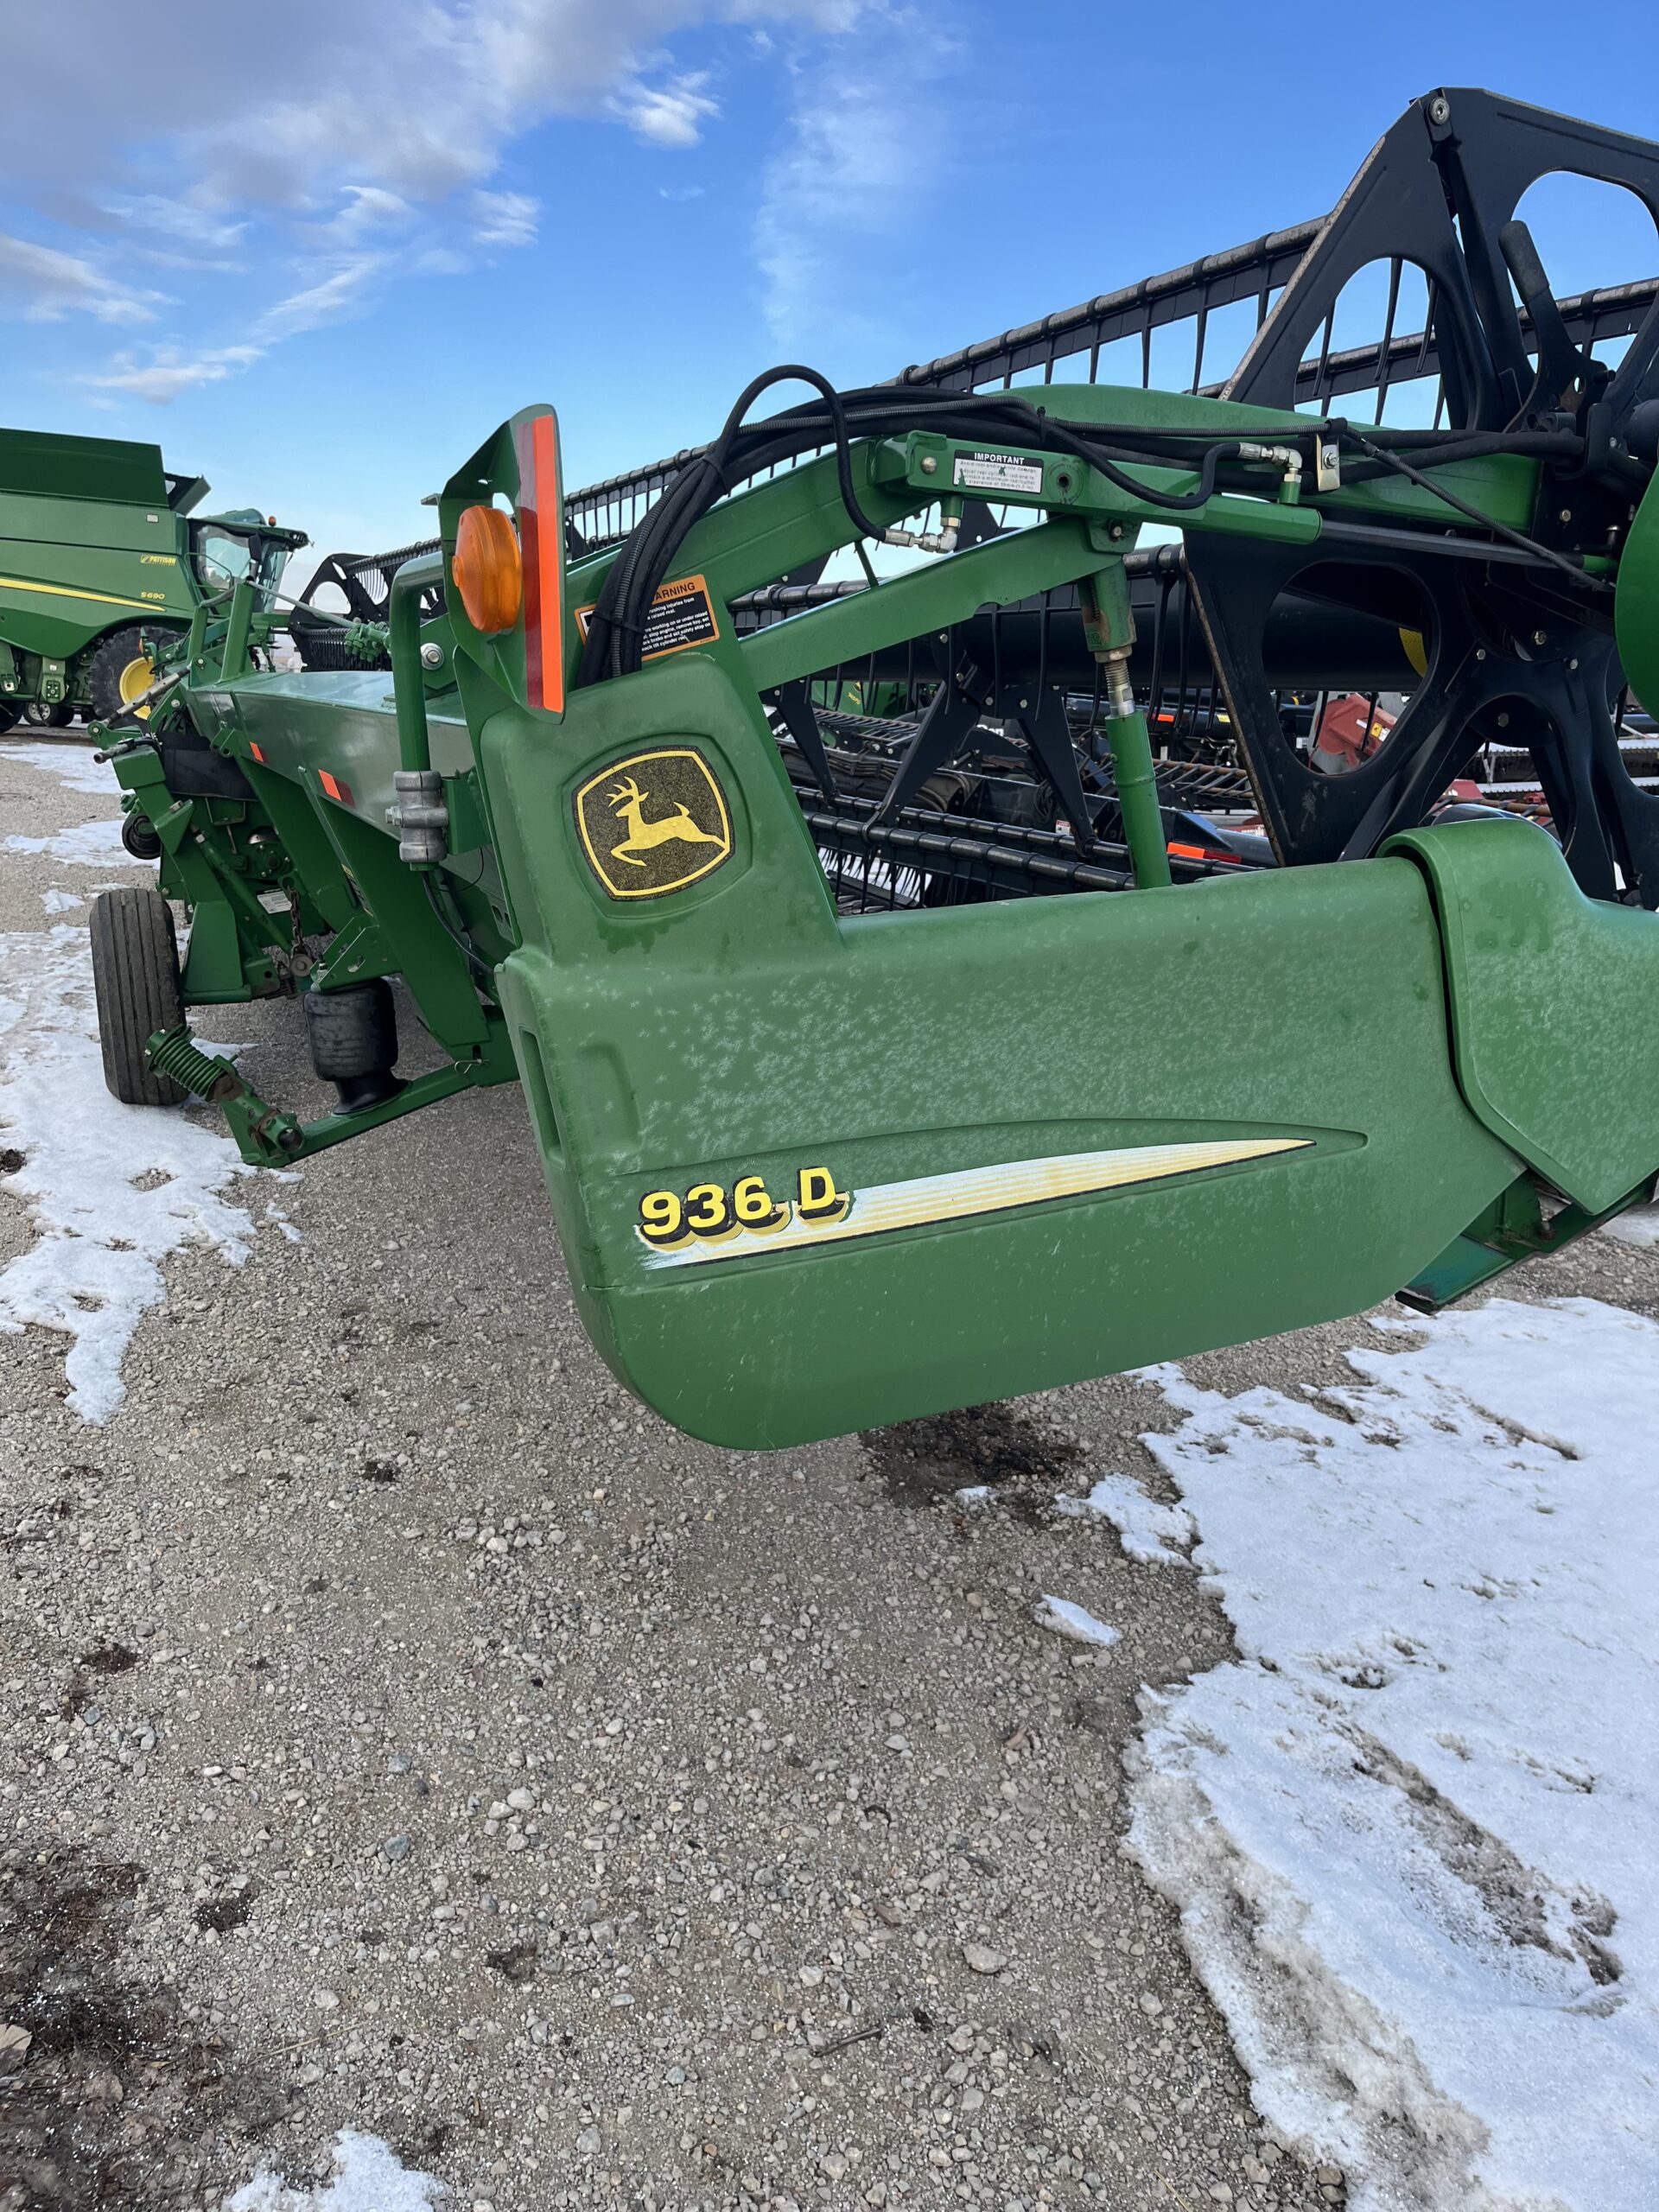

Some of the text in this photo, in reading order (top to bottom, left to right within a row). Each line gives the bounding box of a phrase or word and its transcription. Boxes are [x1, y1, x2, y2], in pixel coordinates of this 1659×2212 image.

[974, 452, 1025, 465] IMPORTANT
[140, 591, 165, 600] S690
[654, 582, 696, 601] ARNING
[648, 605, 667, 614] rushing
[652, 622, 670, 631] working
[694, 610, 708, 619] raised
[659, 638, 677, 647] cylinder
[639, 1166, 842, 1246] 936 D
